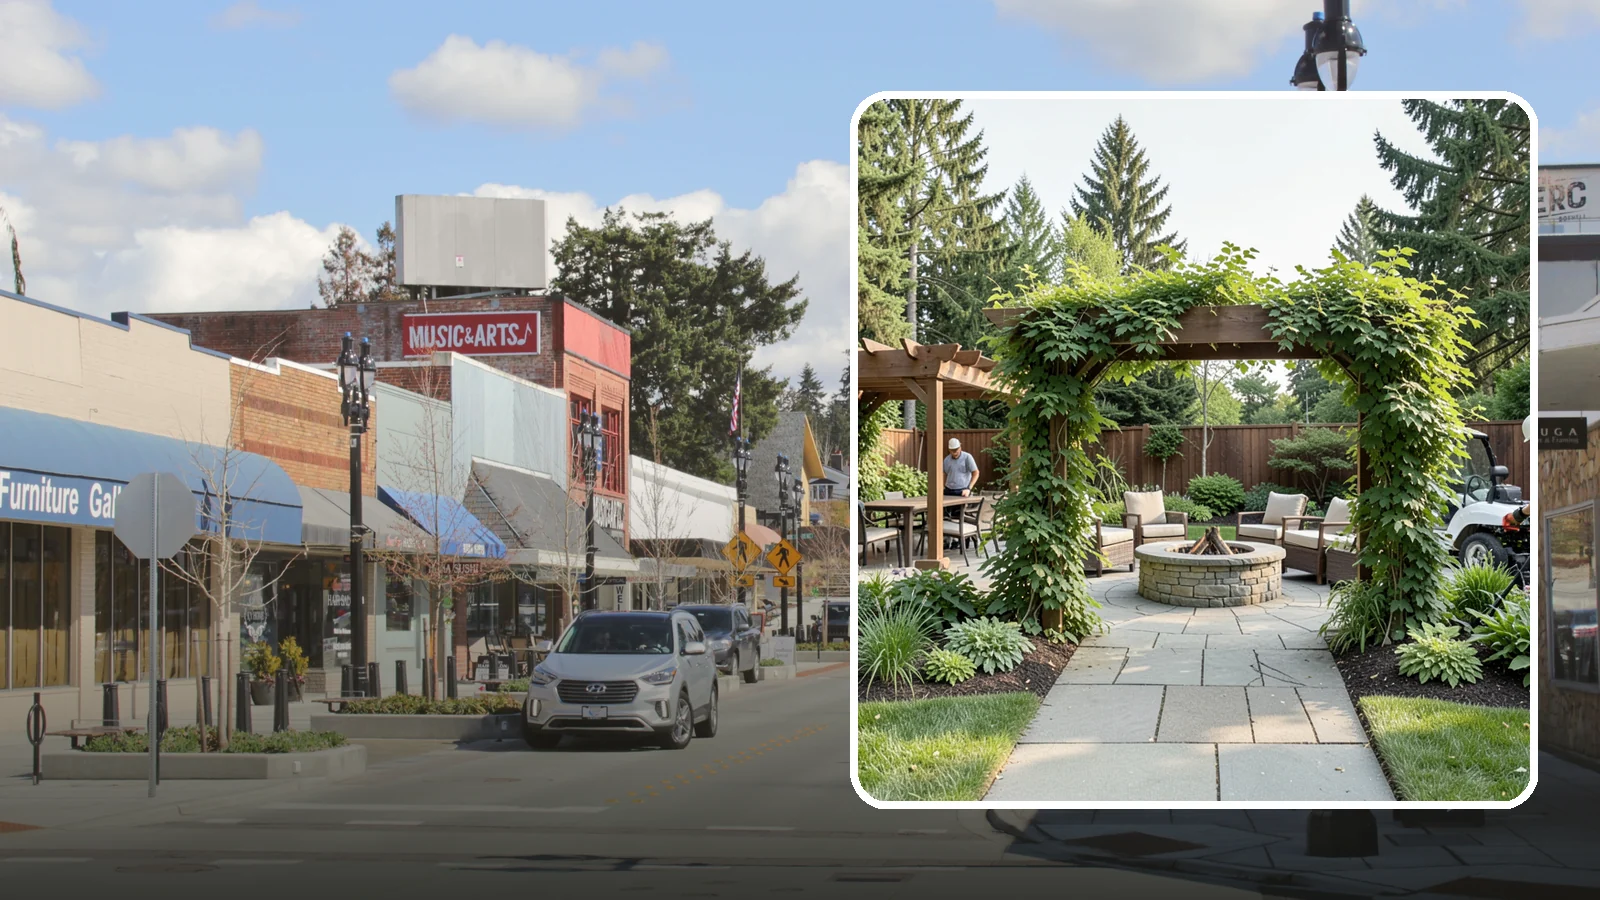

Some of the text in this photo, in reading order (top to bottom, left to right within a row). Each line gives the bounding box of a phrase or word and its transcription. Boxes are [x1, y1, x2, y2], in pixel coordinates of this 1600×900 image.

[408, 322, 519, 348] MUSIC&ARTS
[0, 471, 79, 515] Furniture
[453, 563, 480, 574] SUSHI
